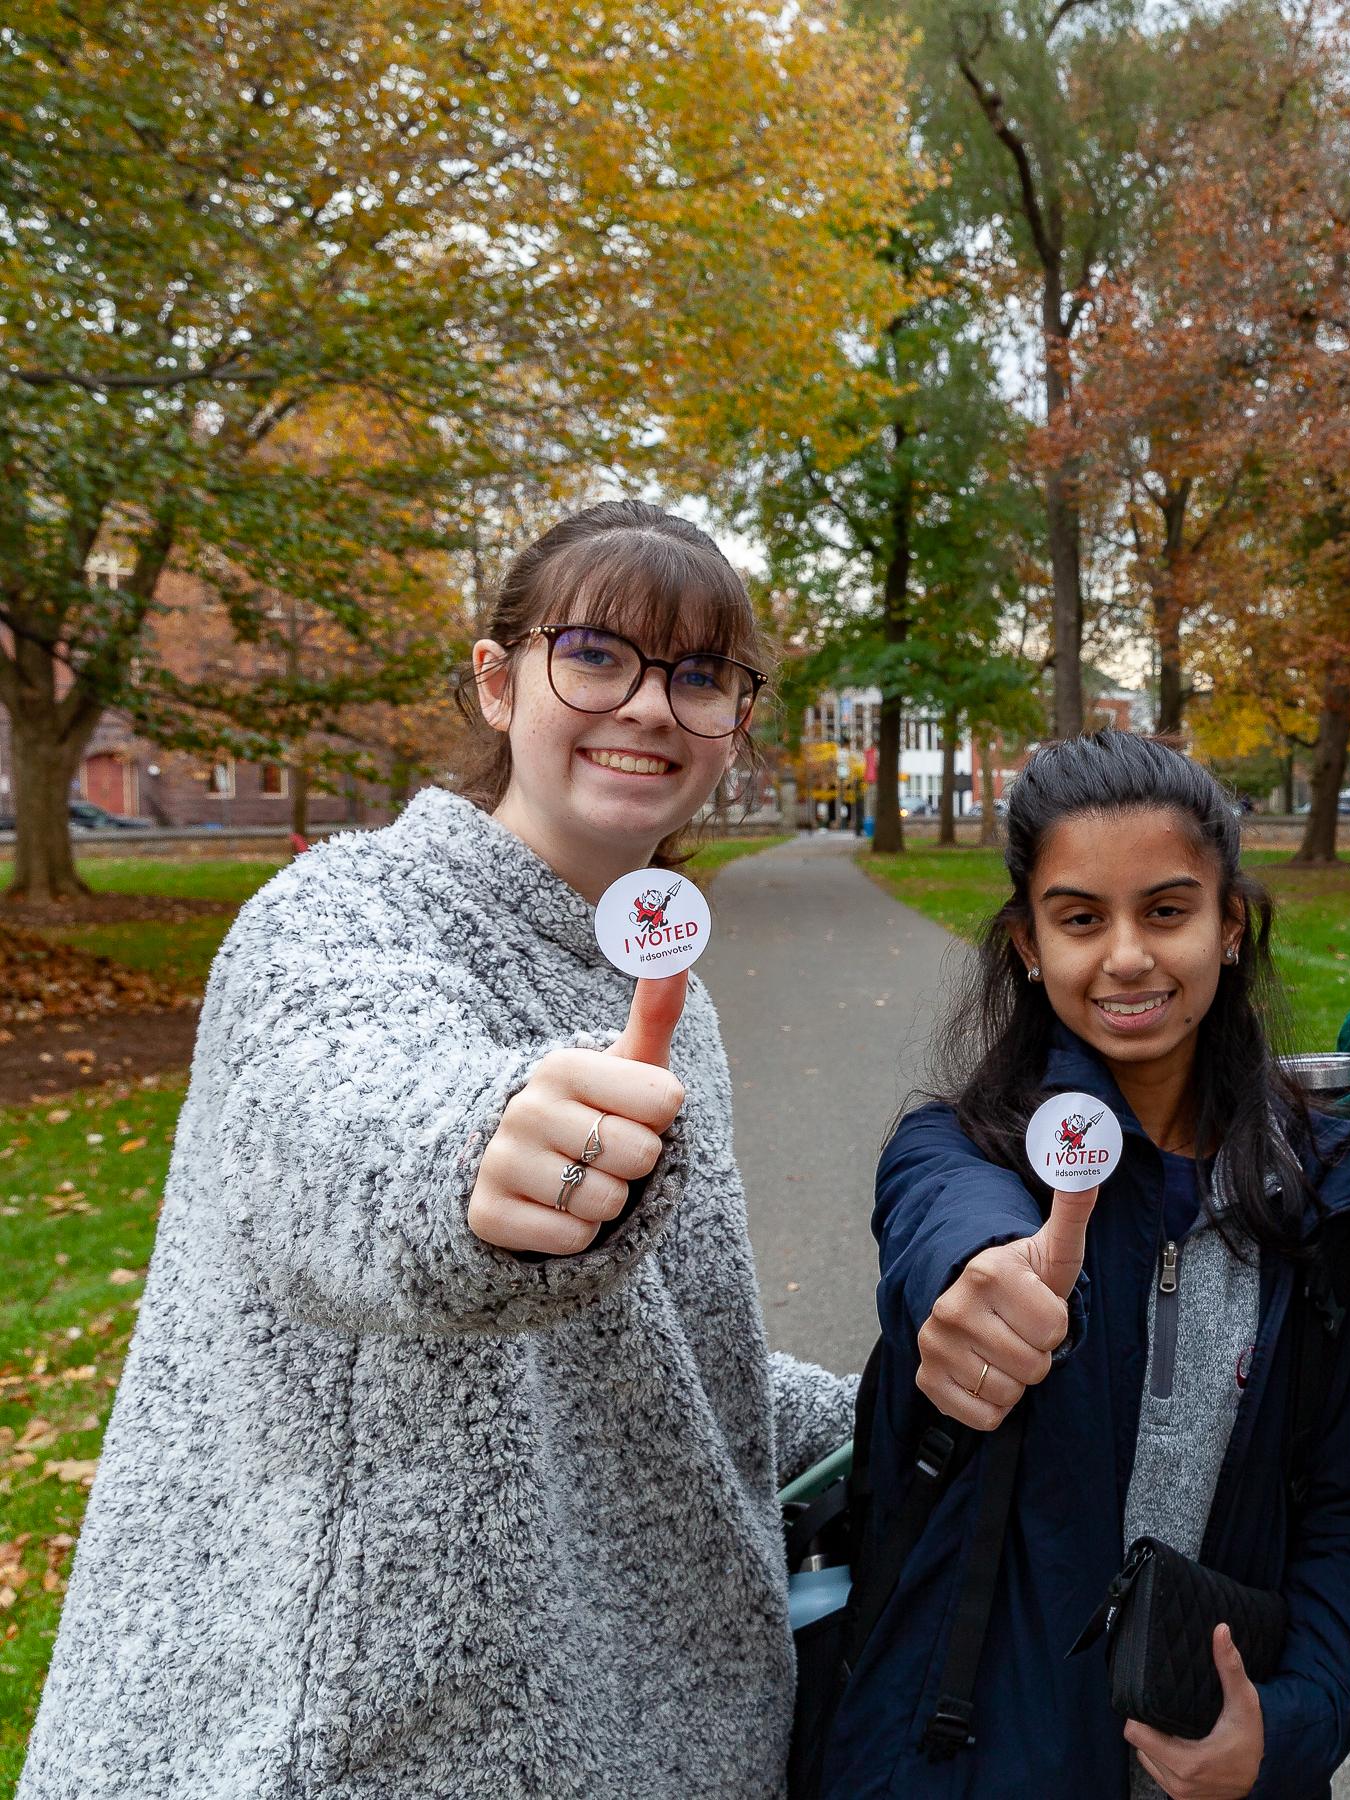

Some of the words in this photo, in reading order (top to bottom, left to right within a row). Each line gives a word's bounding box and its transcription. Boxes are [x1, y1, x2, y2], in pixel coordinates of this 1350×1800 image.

[625, 938, 630, 954] I
[635, 921, 698, 950] VOTED
[639, 943, 693, 963] #dsonvotes
[1046, 1152, 1051, 1166] I
[1055, 1149, 1109, 1166] VOTED
[1055, 1168, 1101, 1177] #dsonvotes
